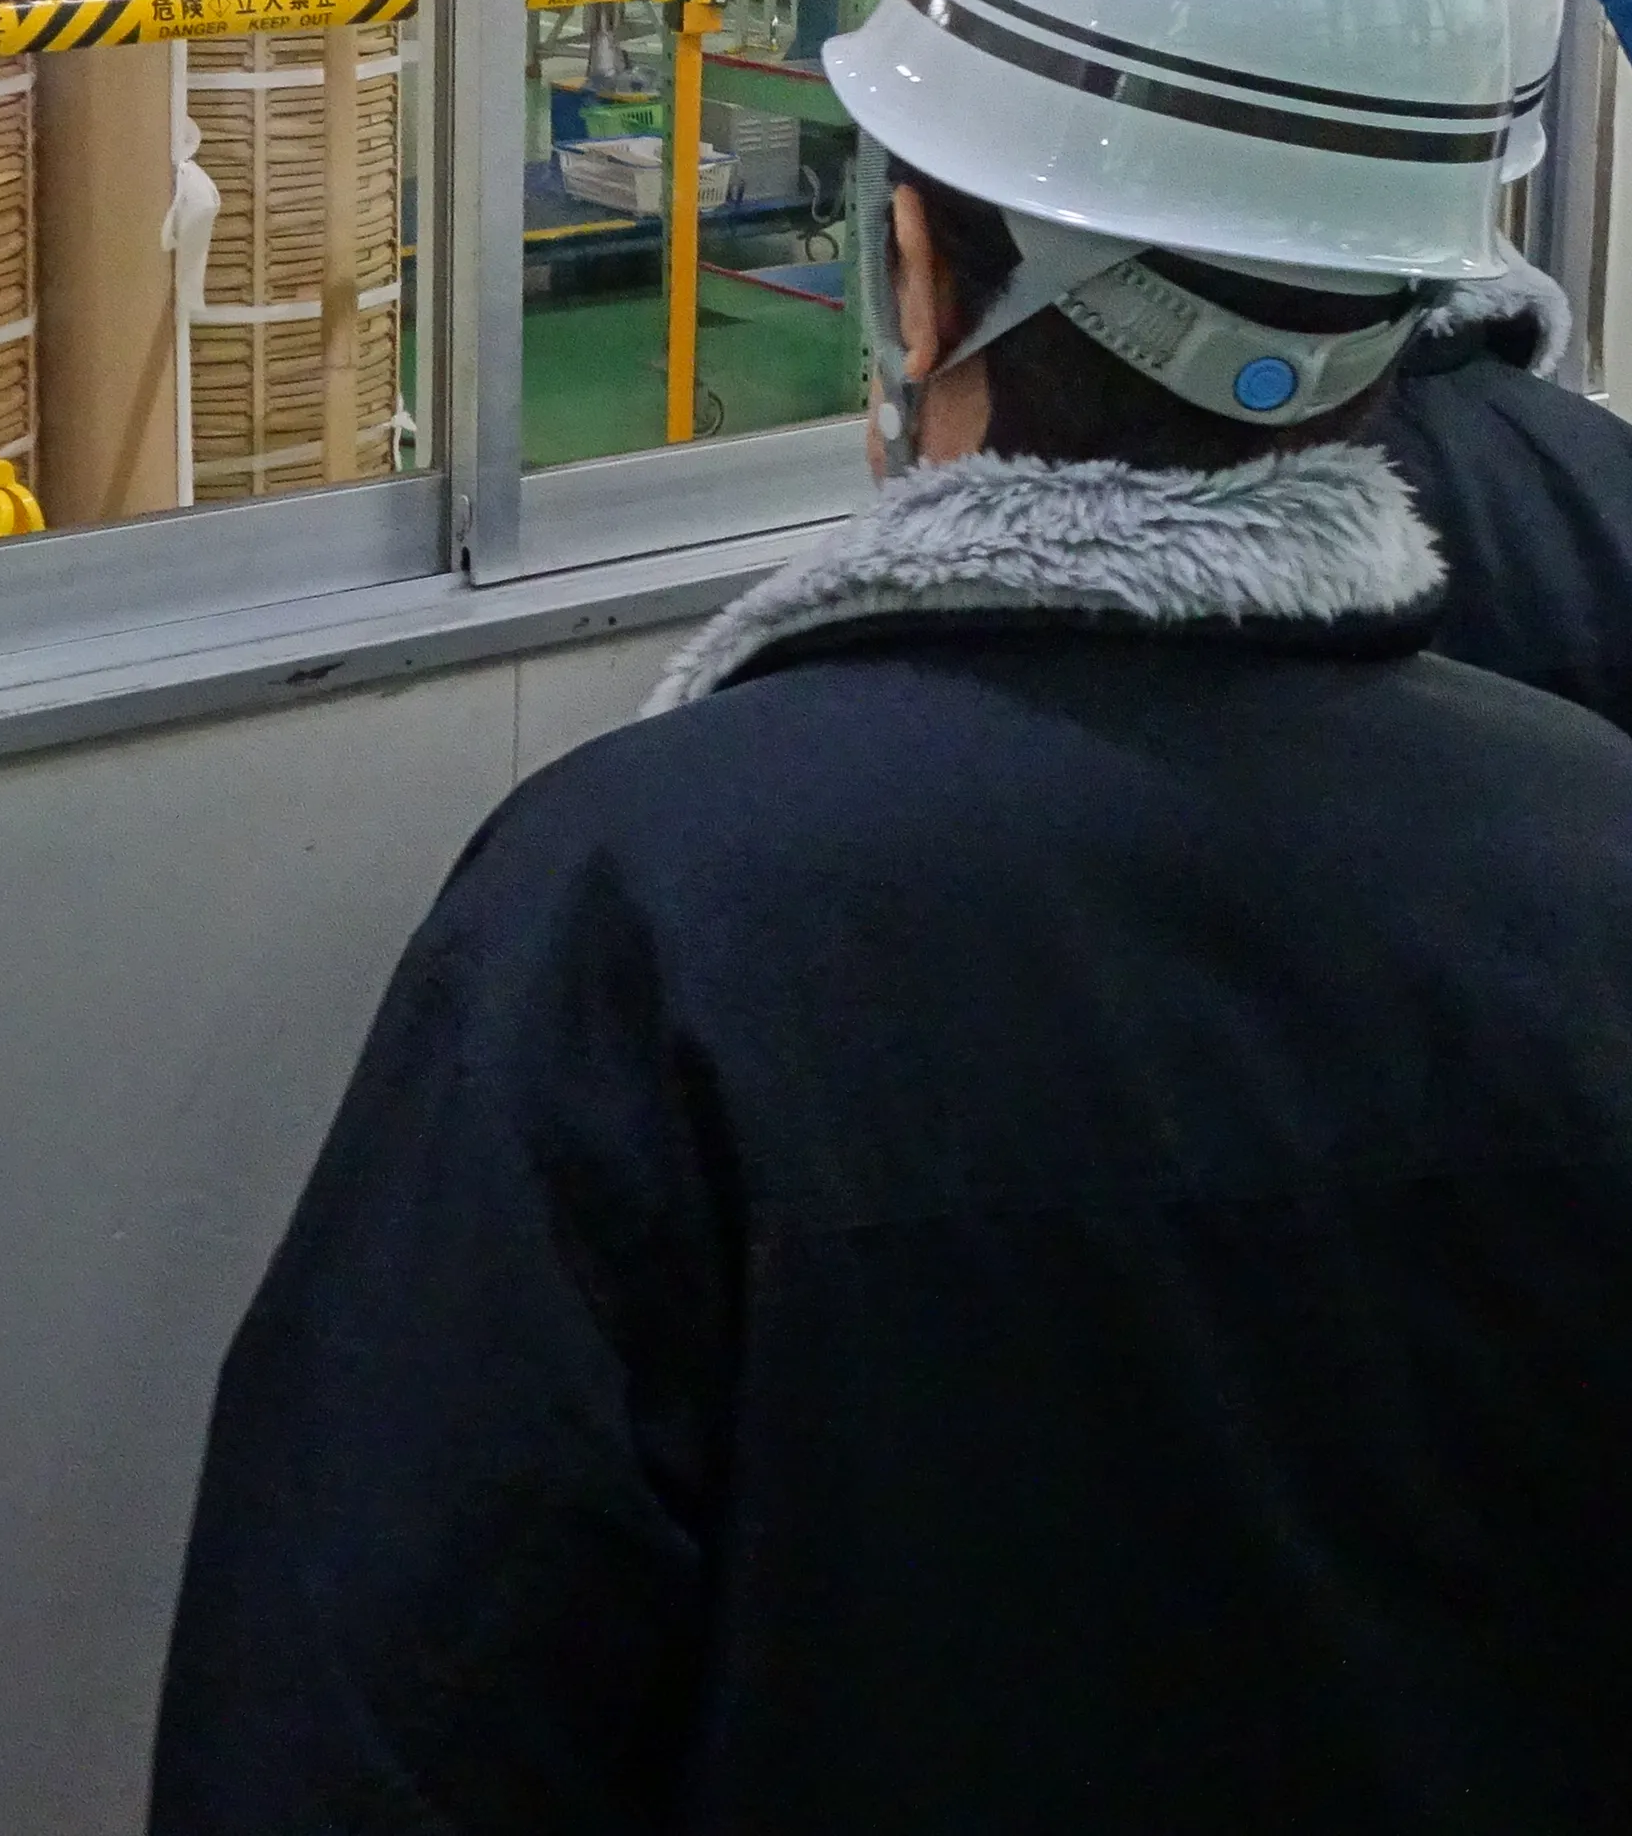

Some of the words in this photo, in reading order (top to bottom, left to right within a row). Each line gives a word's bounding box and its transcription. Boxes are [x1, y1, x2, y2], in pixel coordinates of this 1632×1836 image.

[158, 20, 229, 39] DANGER
[248, 16, 292, 33] KEEP
[299, 12, 333, 28] OUT
